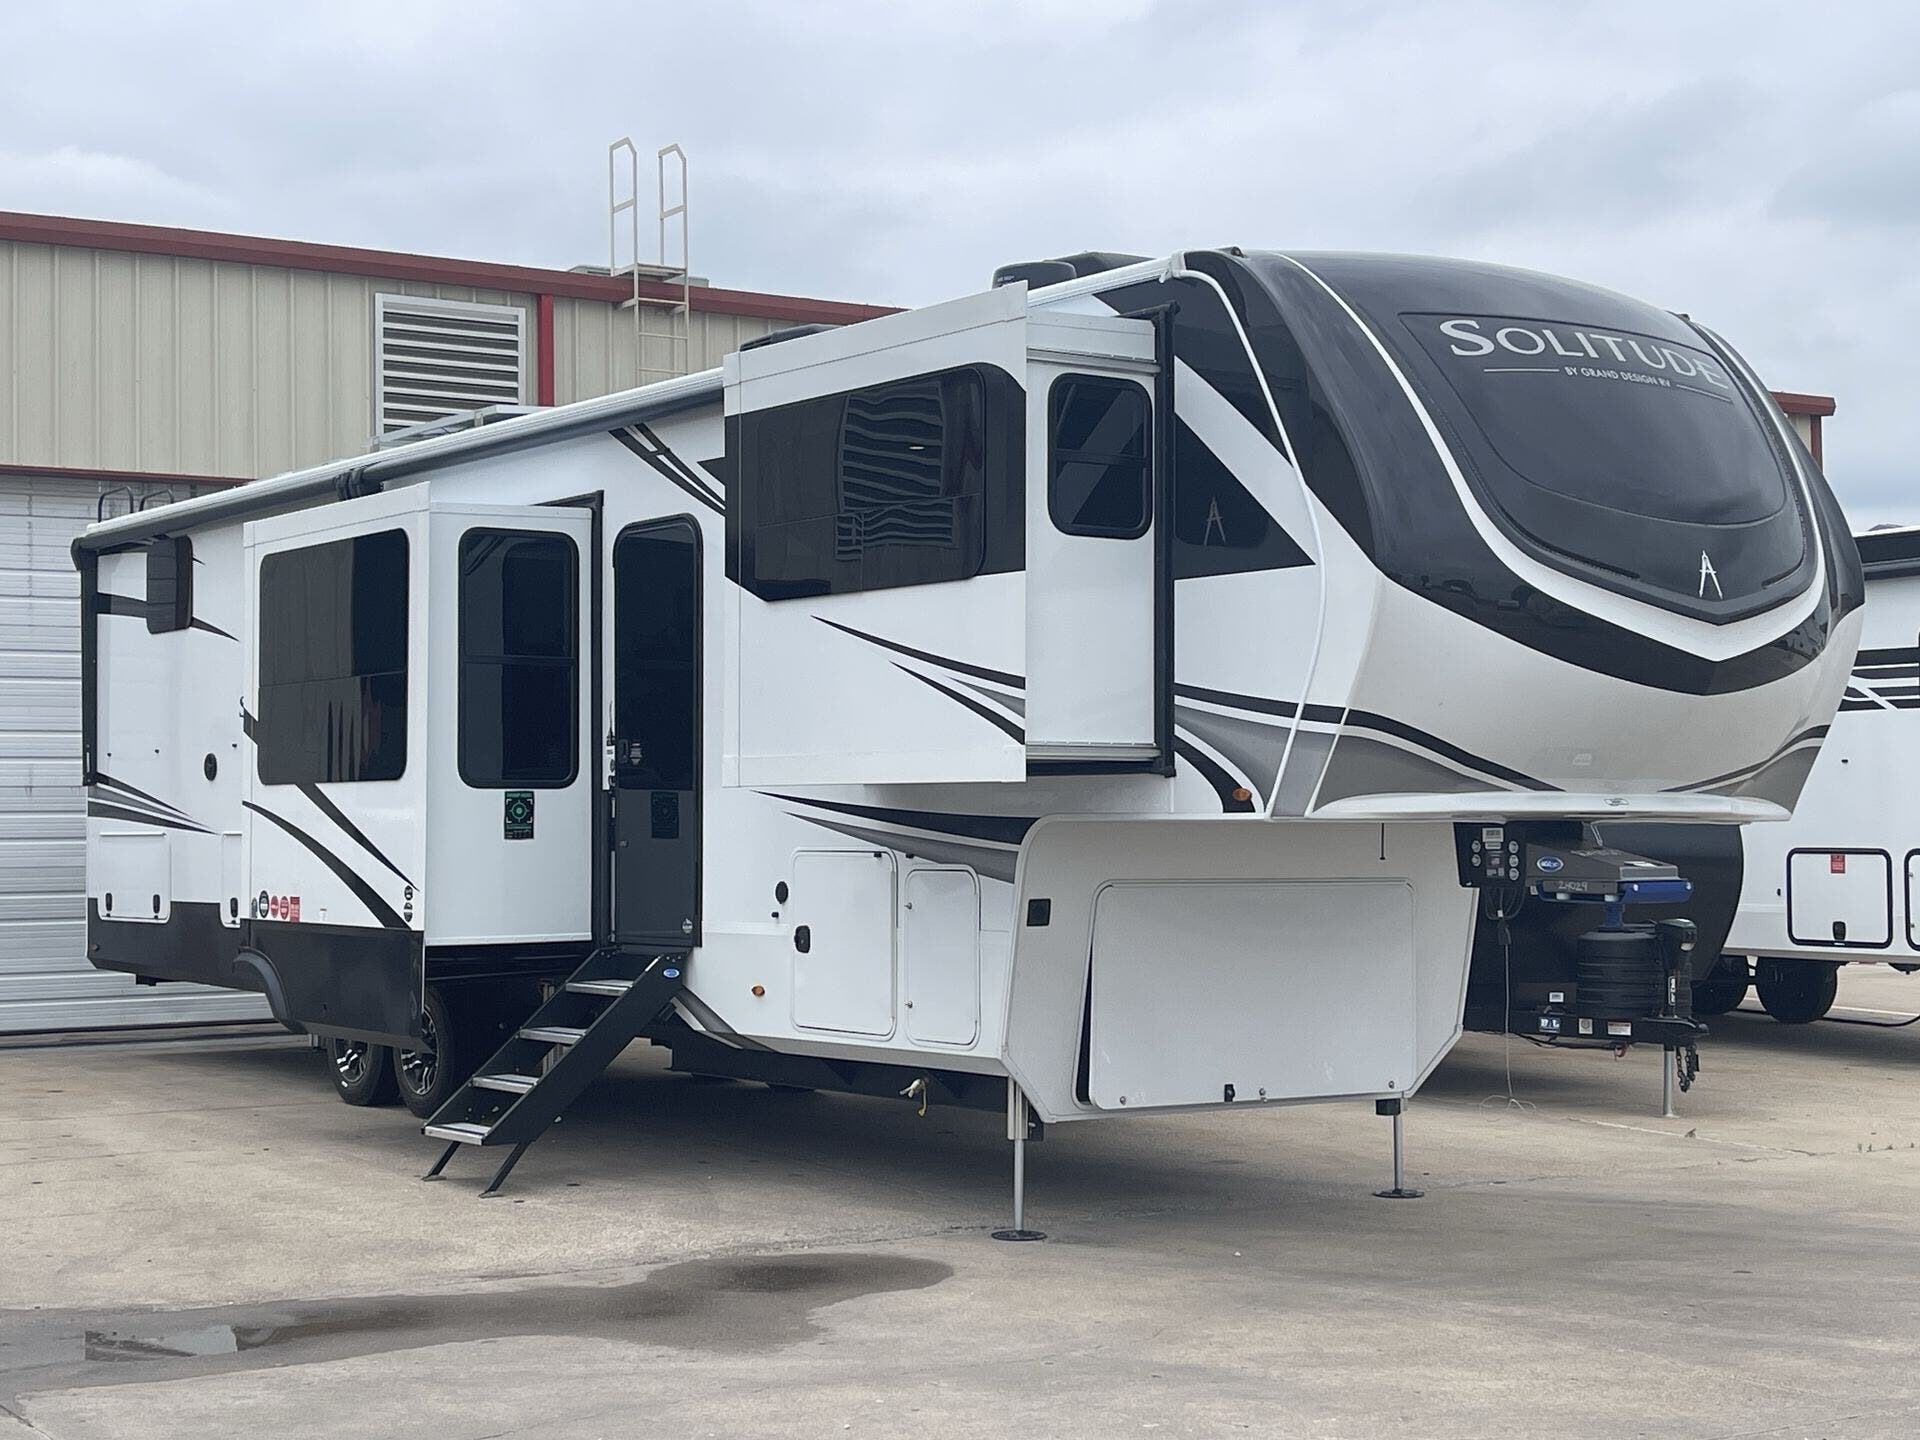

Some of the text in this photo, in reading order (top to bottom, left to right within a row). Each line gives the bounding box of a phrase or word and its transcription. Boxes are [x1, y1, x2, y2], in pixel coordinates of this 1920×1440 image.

[1439, 319, 1729, 389] SOLITUDE
[1564, 366, 1671, 387] BY GRAND DESIGN RV
[1558, 880, 1588, 892] 24029
